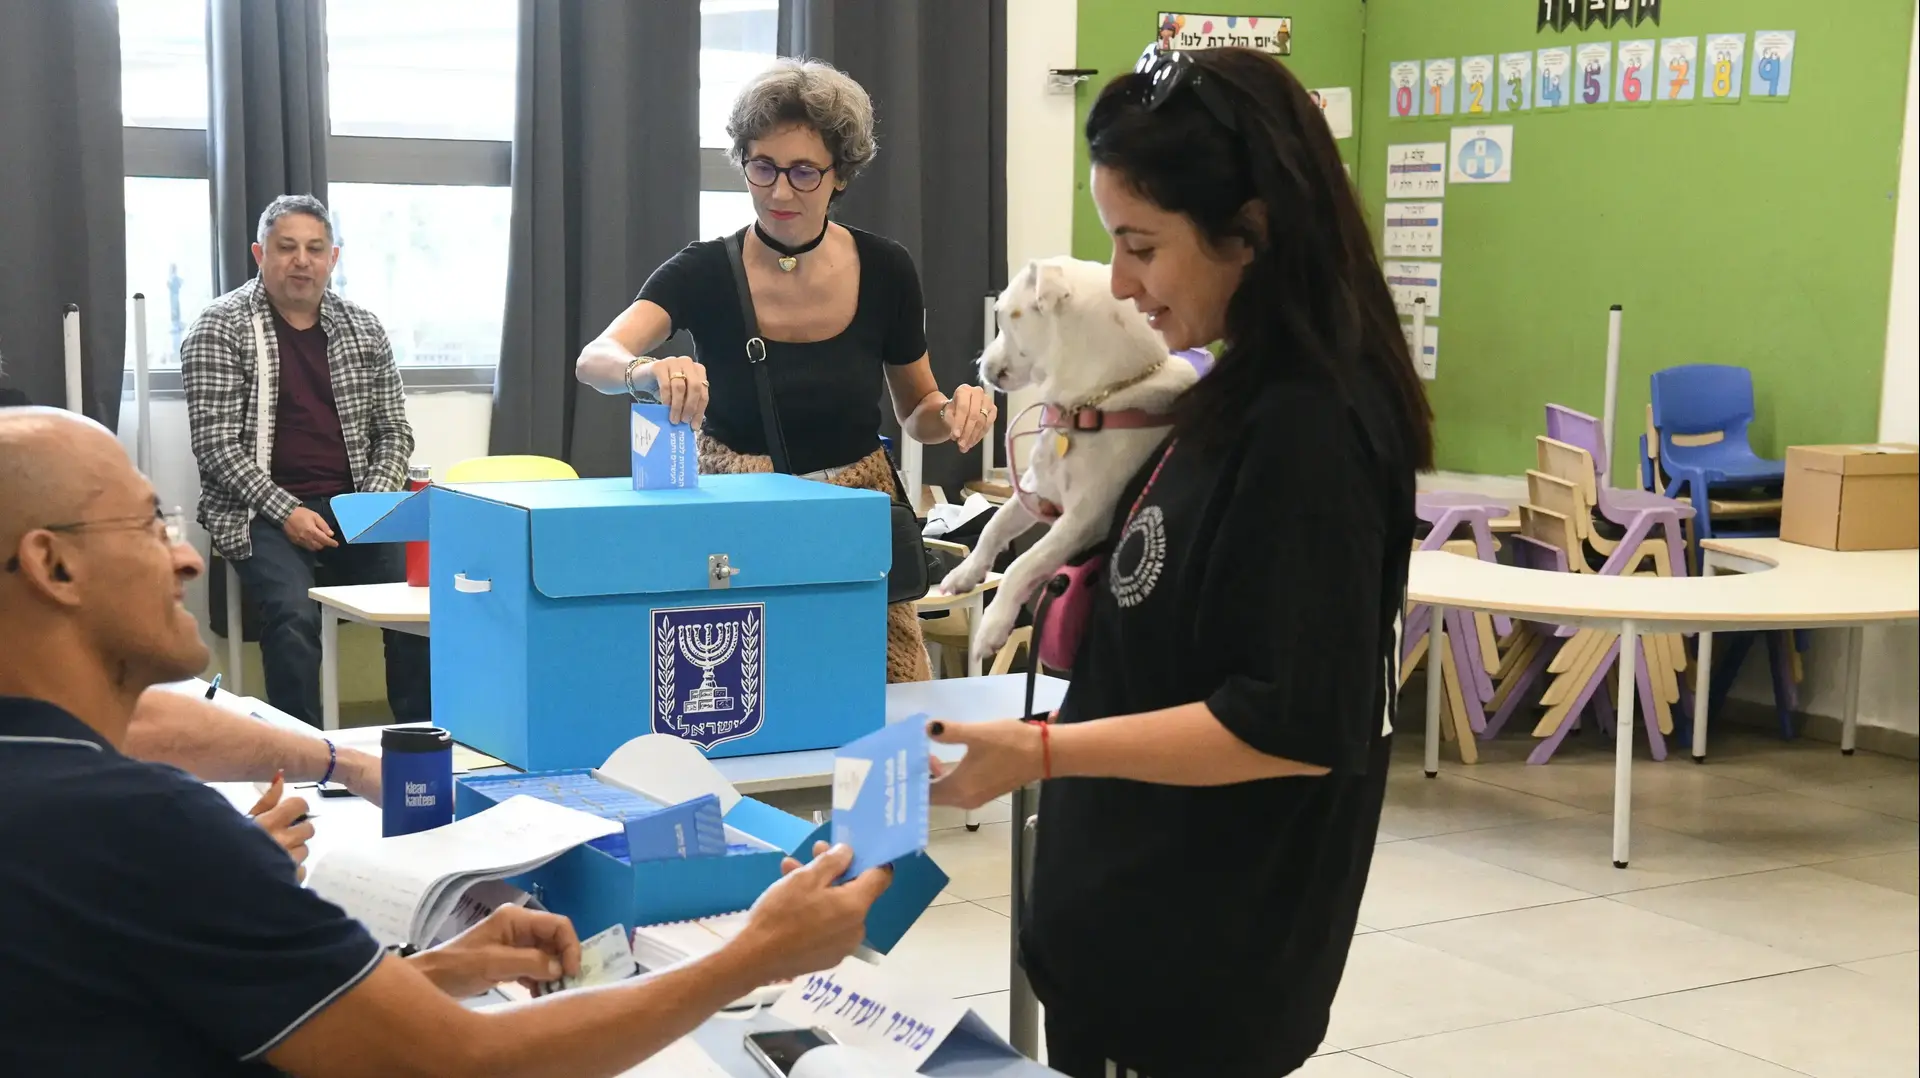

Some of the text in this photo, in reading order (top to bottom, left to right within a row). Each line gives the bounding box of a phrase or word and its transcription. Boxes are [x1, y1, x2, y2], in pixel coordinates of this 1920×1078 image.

[1181, 32, 1202, 46] לנו!
[1254, 36, 1271, 47] יום
[1542, 68, 1562, 106] 4
[1583, 63, 1600, 104] 5
[1622, 65, 1642, 102] 6
[1669, 60, 1689, 99] 7
[1712, 60, 1732, 97] 8
[1758, 57, 1780, 97] 9
[1396, 86, 1412, 116] 0
[1429, 85, 1442, 115] 1
[1469, 81, 1485, 113] 2
[1506, 77, 1523, 111] 3
[677, 715, 740, 737] ישראל
[405, 781, 427, 794] klean
[405, 794, 436, 807] kanteen
[802, 973, 935, 1051] מזכיר ועדת קלפי
